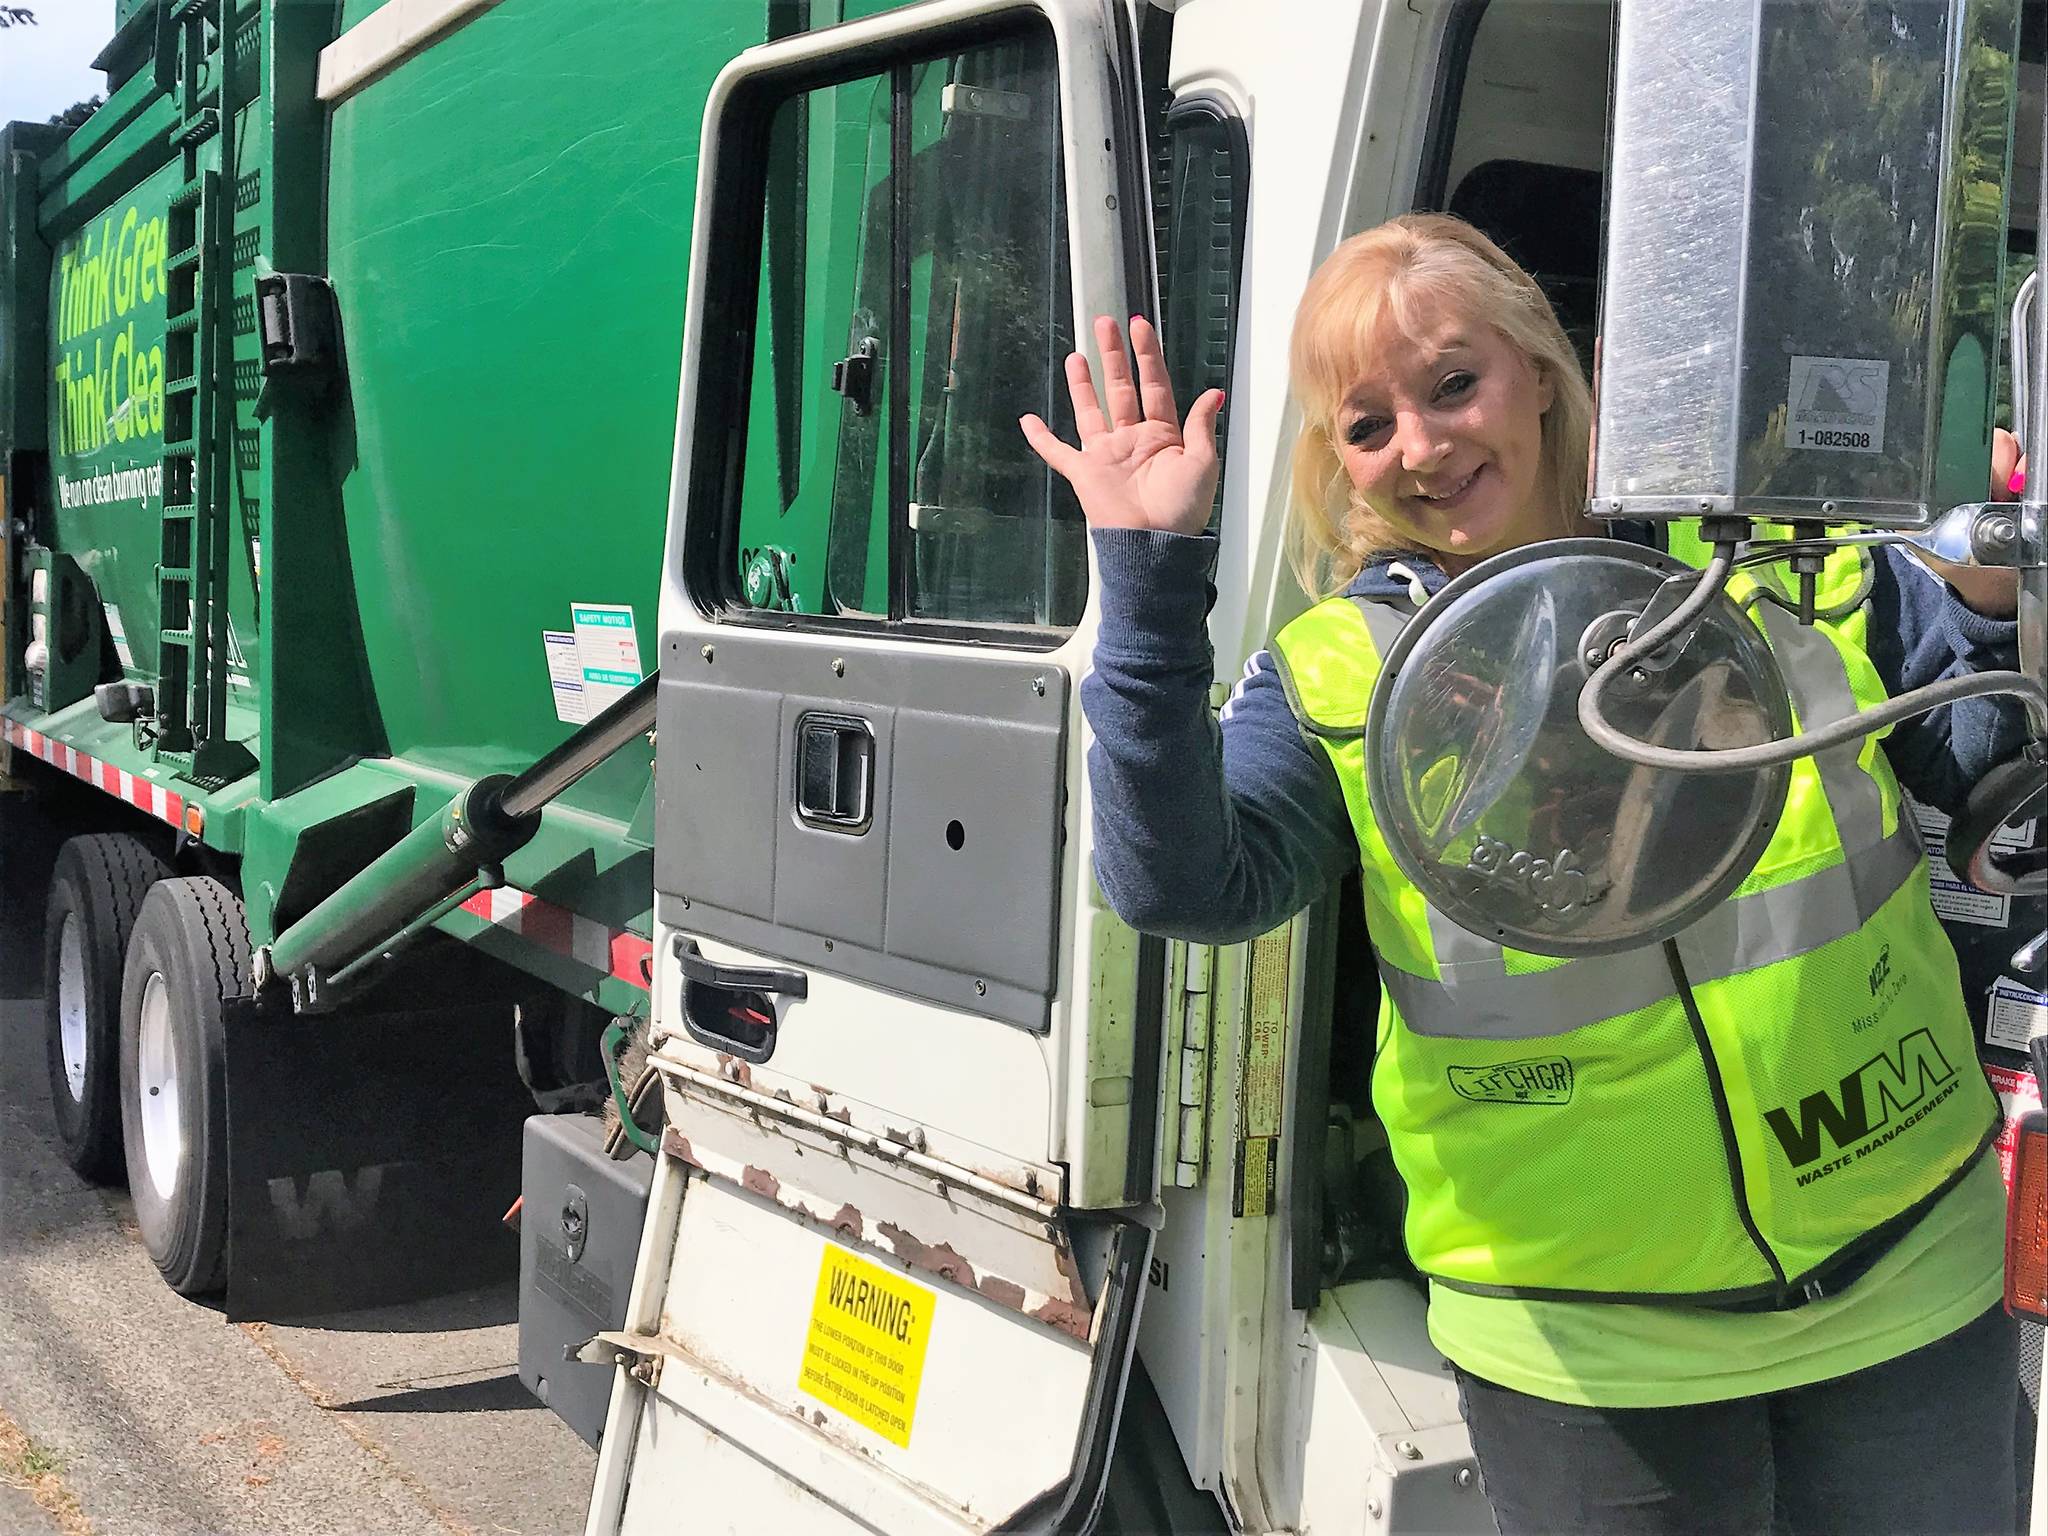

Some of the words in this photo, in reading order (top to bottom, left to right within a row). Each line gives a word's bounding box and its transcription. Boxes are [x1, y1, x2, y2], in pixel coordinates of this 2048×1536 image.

[59, 218, 115, 345] Think
[114, 206, 166, 317] Gree
[55, 338, 110, 457] Think
[112, 320, 162, 443] Clea
[1798, 429, 1870, 448] 1-082508
[58, 473, 71, 510] We
[70, 480, 82, 508] run
[82, 476, 93, 506] on
[93, 464, 113, 504] clean
[112, 460, 147, 510] burning
[1261, 1021, 1269, 1056] LOWER
[1270, 1021, 1278, 1034] TO
[1763, 1027, 1955, 1169] WM
[1991, 1074, 2016, 1087] BRAKE
[1796, 1153, 1853, 1188] WASTE
[1855, 1079, 1960, 1159] MANAGEMENT
[829, 1265, 916, 1345] WARNING:
[808, 1343, 824, 1359] MUST
[824, 1350, 832, 1363] BE
[831, 1354, 852, 1374] LOCKED
[852, 1367, 860, 1378] IN
[859, 1370, 871, 1384] THE
[870, 1377, 880, 1388] UP
[879, 1381, 906, 1404] POSITION
[812, 1319, 824, 1333] THE
[823, 1325, 842, 1341] LOWER
[842, 1334, 866, 1355] PORTION
[866, 1346, 875, 1359] OF
[874, 1351, 888, 1367] THIS
[887, 1358, 905, 1376] DOOR
[804, 1366, 824, 1386] BEFORE
[823, 1375, 843, 1397] ENTIRE
[842, 1385, 859, 1405] DOOR
[858, 1397, 866, 1409] IS
[865, 1400, 890, 1423] LATCHED
